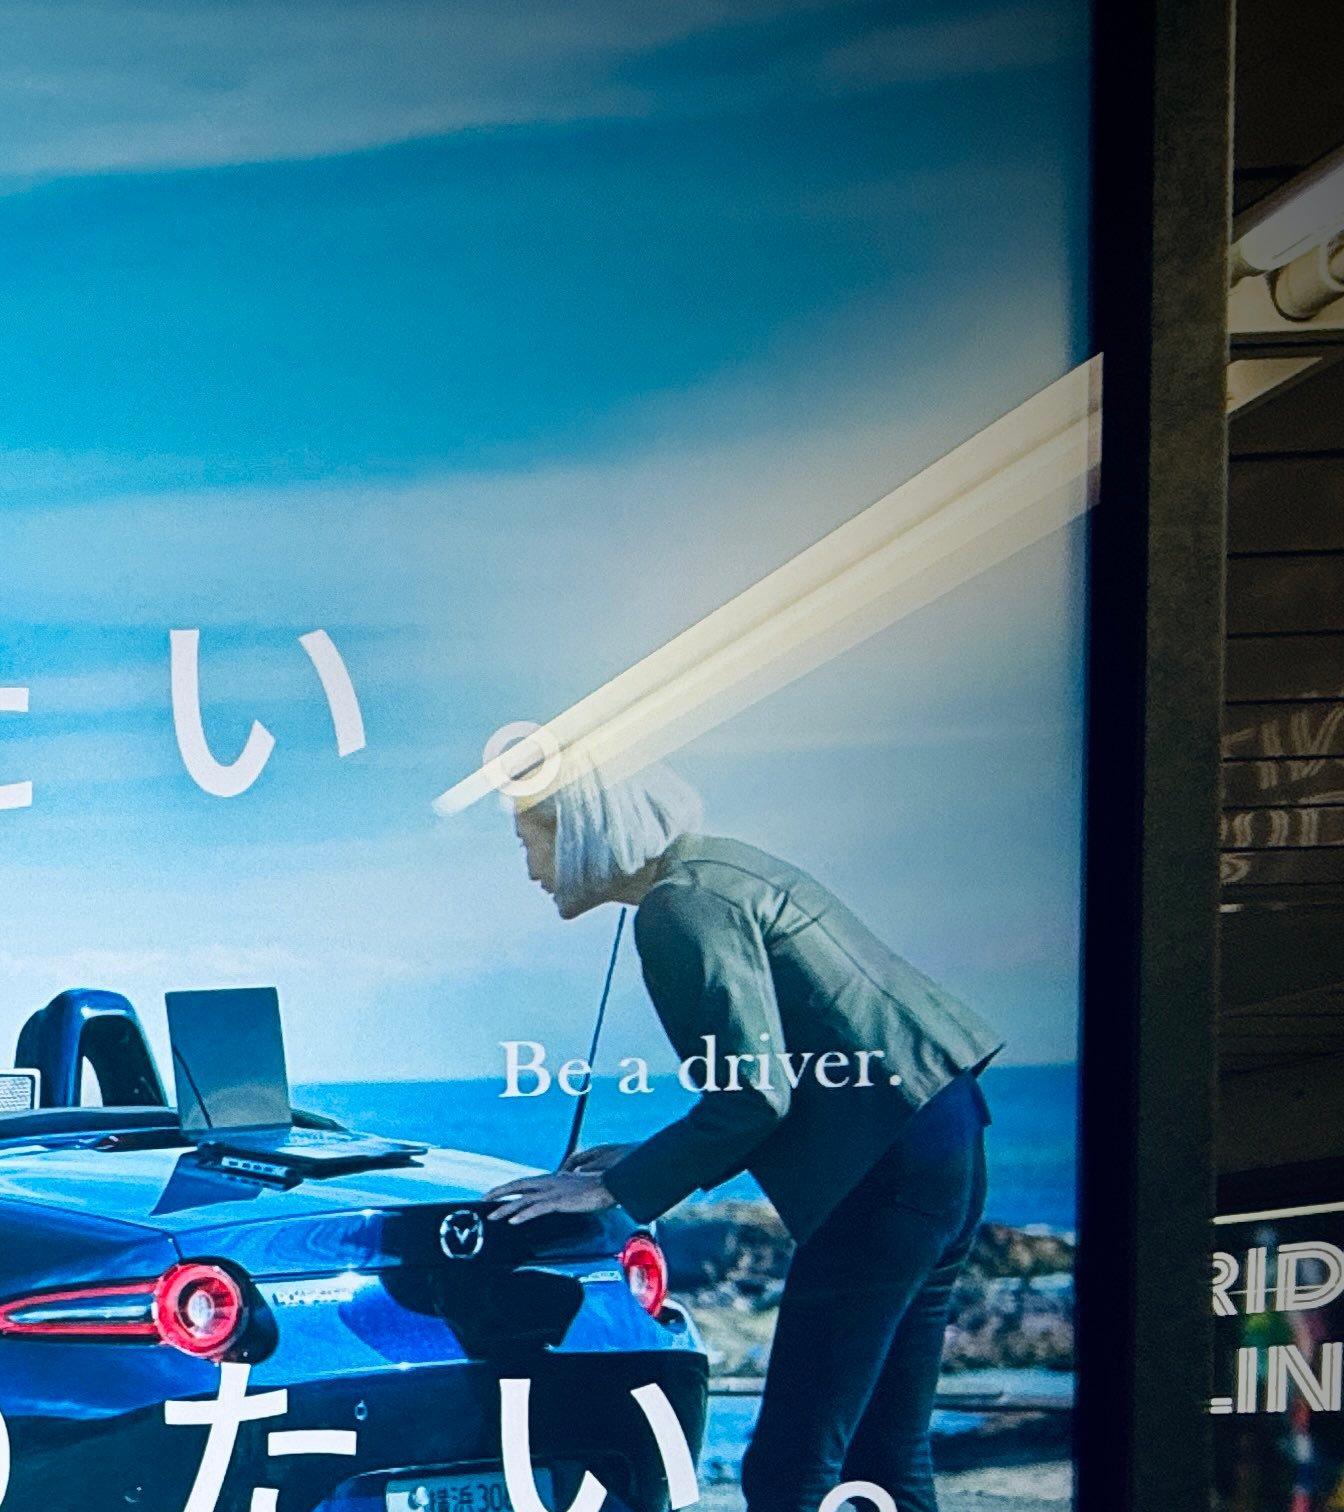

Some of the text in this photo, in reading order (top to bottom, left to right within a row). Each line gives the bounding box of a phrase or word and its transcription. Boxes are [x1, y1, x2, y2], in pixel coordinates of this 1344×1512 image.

[498, 1033, 903, 1099] Be a driver.
[1209, 1341, 1344, 1414] IN
